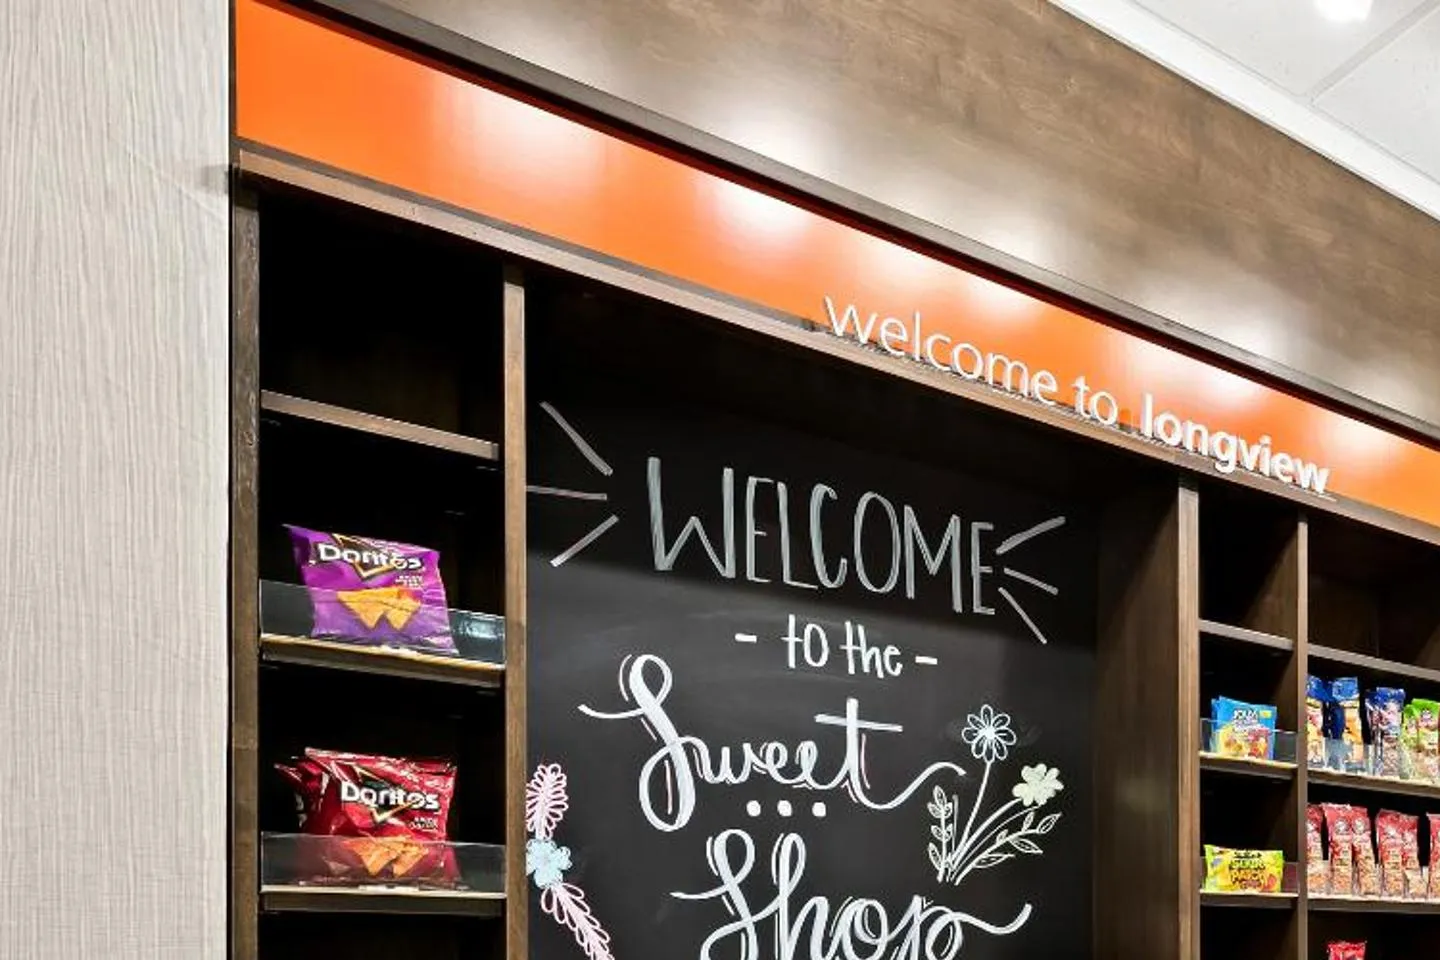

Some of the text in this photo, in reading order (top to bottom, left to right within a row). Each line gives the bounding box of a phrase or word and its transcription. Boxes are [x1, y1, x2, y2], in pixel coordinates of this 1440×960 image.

[823, 295, 1331, 495] welcome to longview
[318, 542, 422, 570] Doritos
[646, 456, 996, 616] WELCOME
[781, 613, 904, 679] to the
[340, 779, 441, 810] Doritos
[578, 653, 967, 832] Sweet
